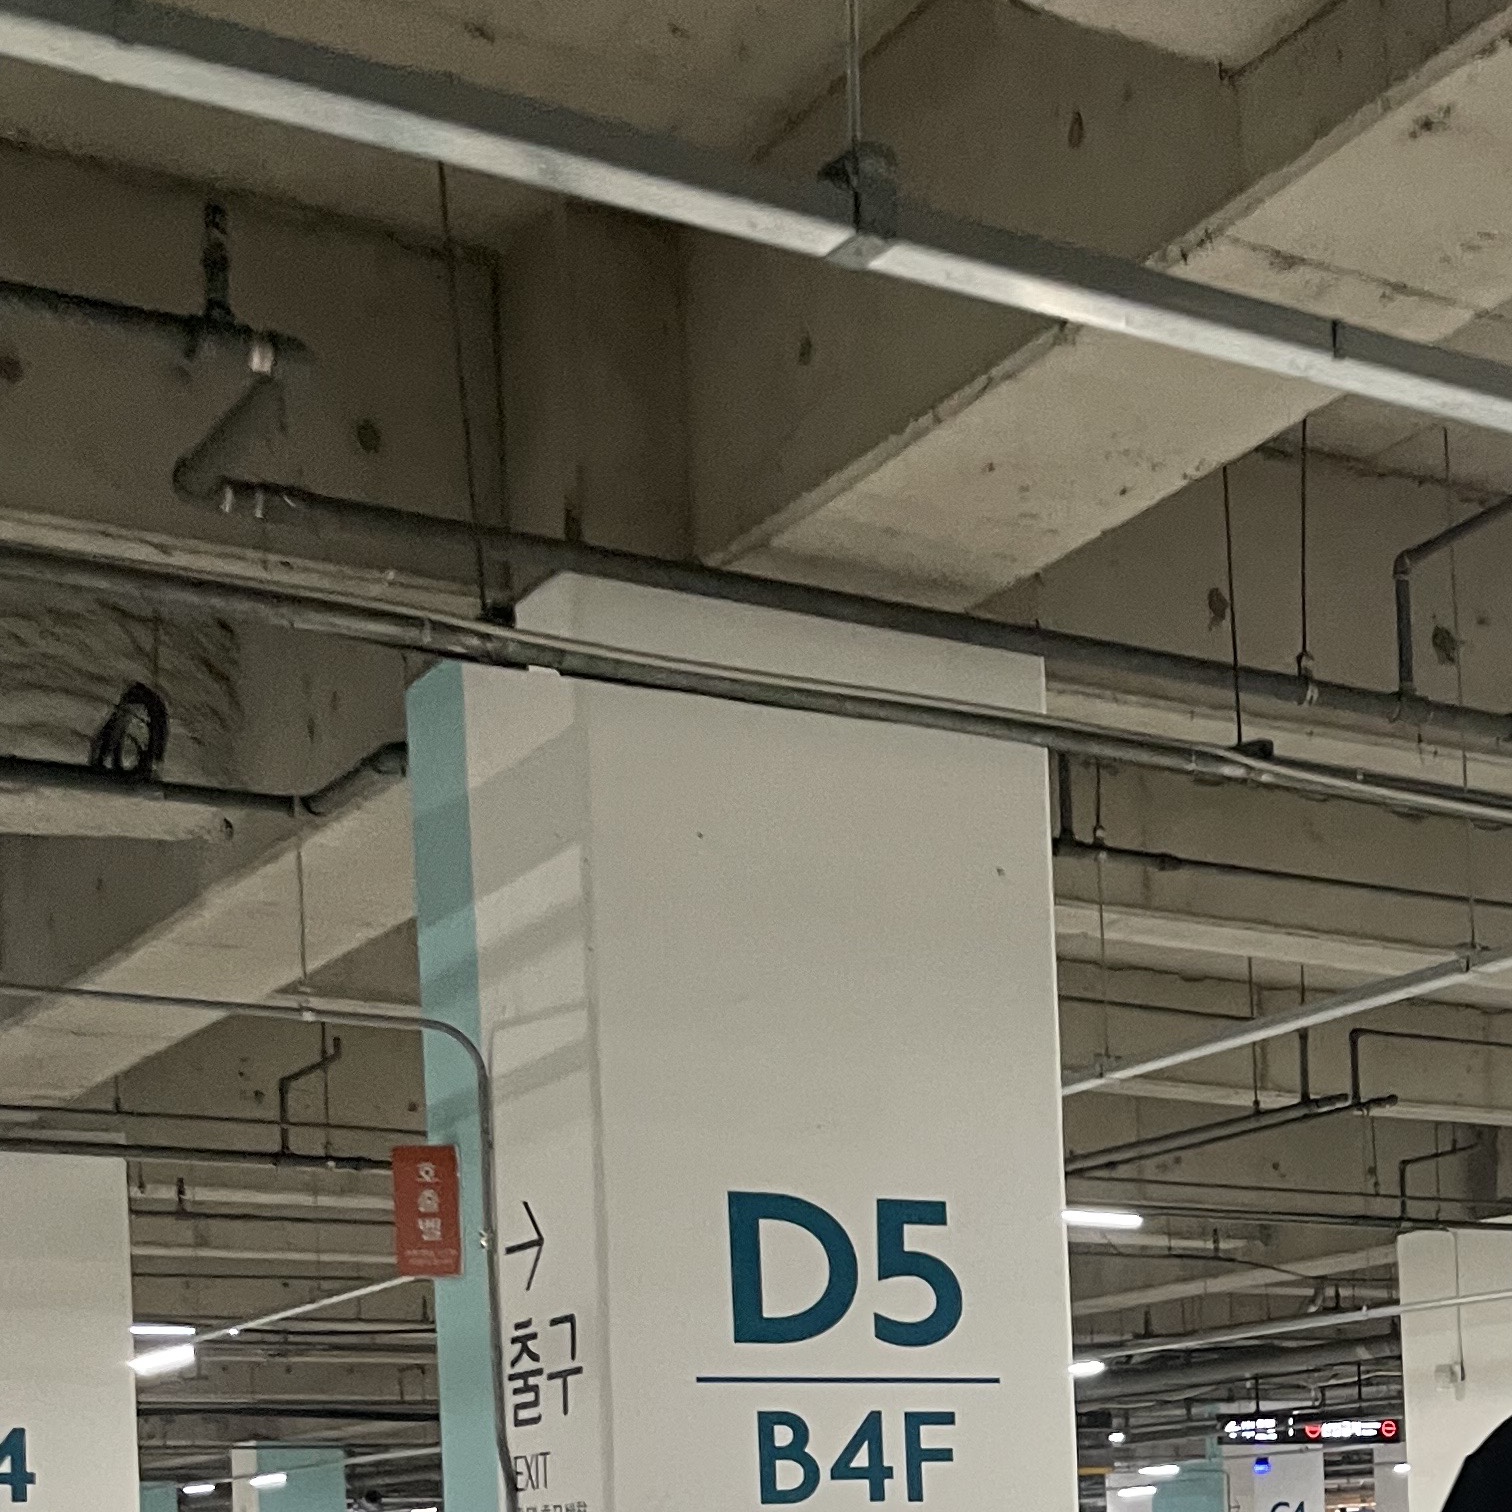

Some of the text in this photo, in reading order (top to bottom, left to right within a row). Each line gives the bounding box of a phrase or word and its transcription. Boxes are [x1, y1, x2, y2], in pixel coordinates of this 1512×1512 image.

[727, 1191, 962, 1347] D5
[508, 1314, 583, 1428] 출구
[513, 1451, 551, 1492] EXIT
[757, 1410, 956, 1505] B4F
